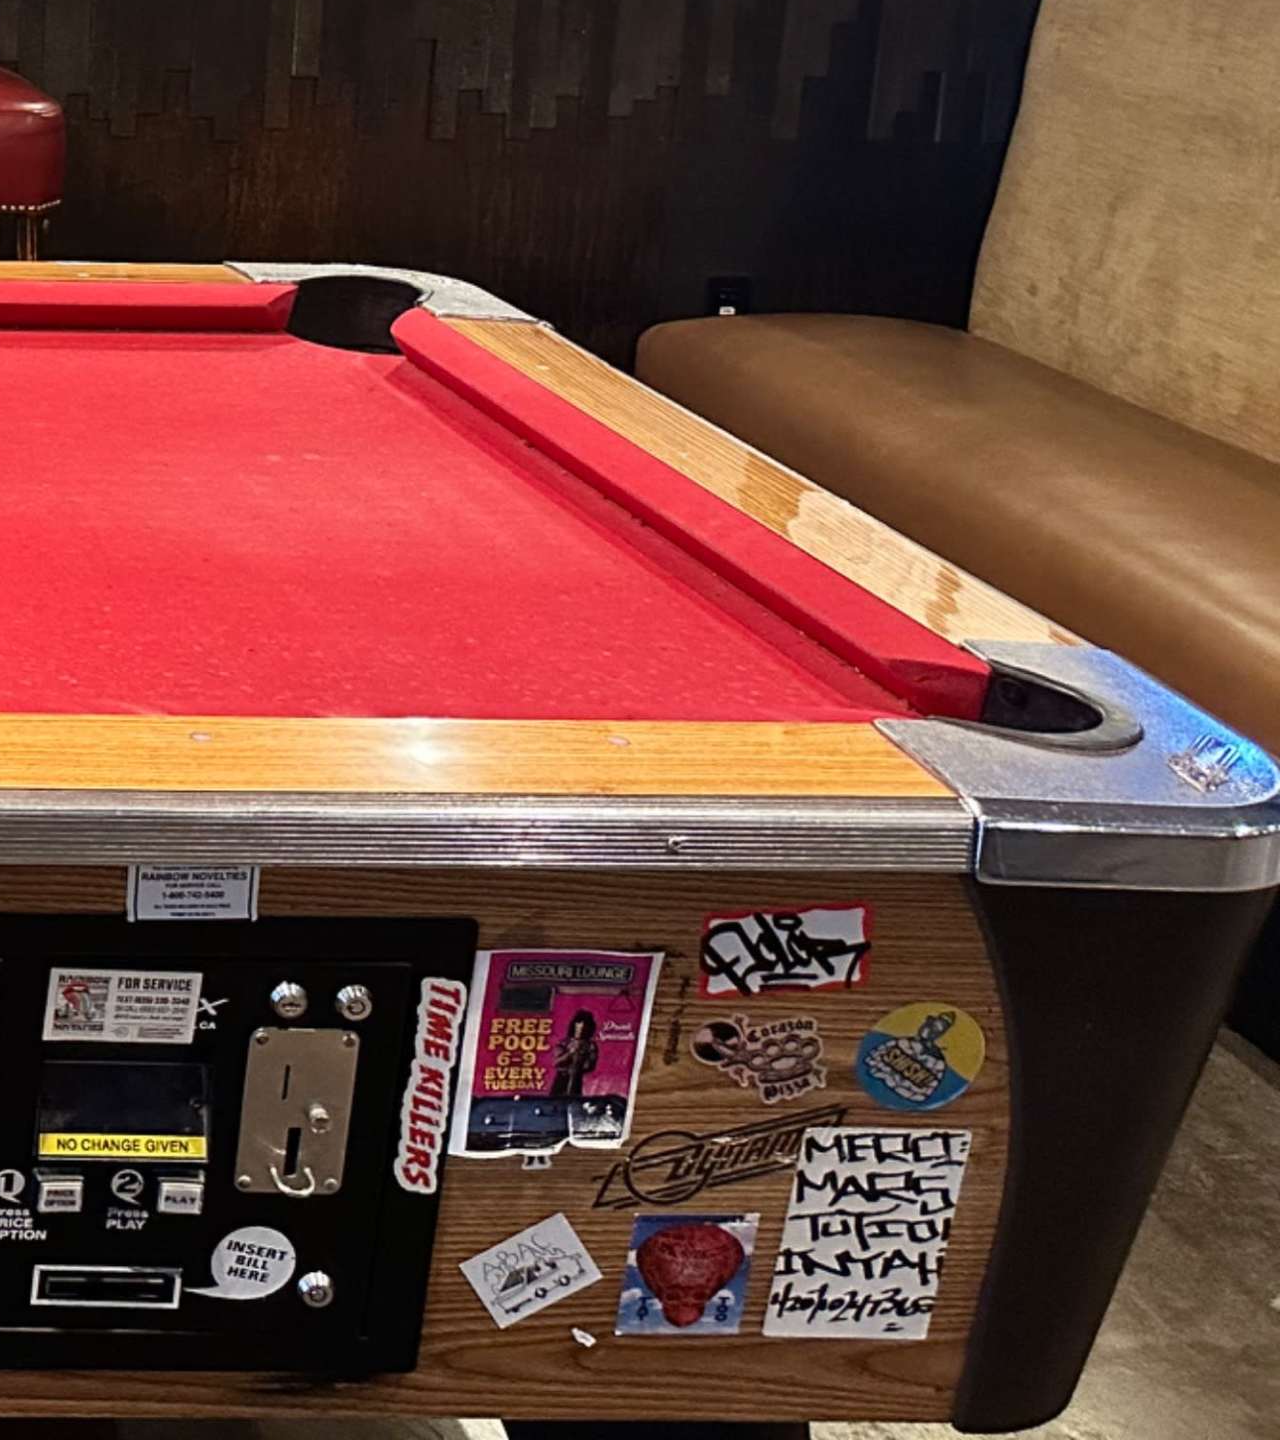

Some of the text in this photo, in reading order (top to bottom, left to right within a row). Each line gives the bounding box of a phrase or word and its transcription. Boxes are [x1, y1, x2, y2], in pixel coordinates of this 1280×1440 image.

[192, 871, 248, 881] NOVELTIES
[510, 965, 628, 979] MISSOURI LOUNGE
[117, 976, 140, 990] FOR
[142, 977, 193, 991] SERVICE
[490, 1018, 554, 1035] FREE
[487, 1035, 551, 1051] POOL
[496, 1051, 537, 1066] 6-9
[483, 1067, 547, 1080] EVERY
[401, 982, 462, 1189] TIME KILLERS
[56, 1138, 189, 1154] NO CHANGE GIVEN
[0, 1172, 16, 1194] 1
[115, 1173, 135, 1194] 2
[164, 1195, 197, 1205] PLAY
[105, 1219, 147, 1230] PLAY
[226, 1239, 289, 1262] INSERT
[234, 1254, 269, 1271] BILL
[226, 1266, 271, 1283] HERE
